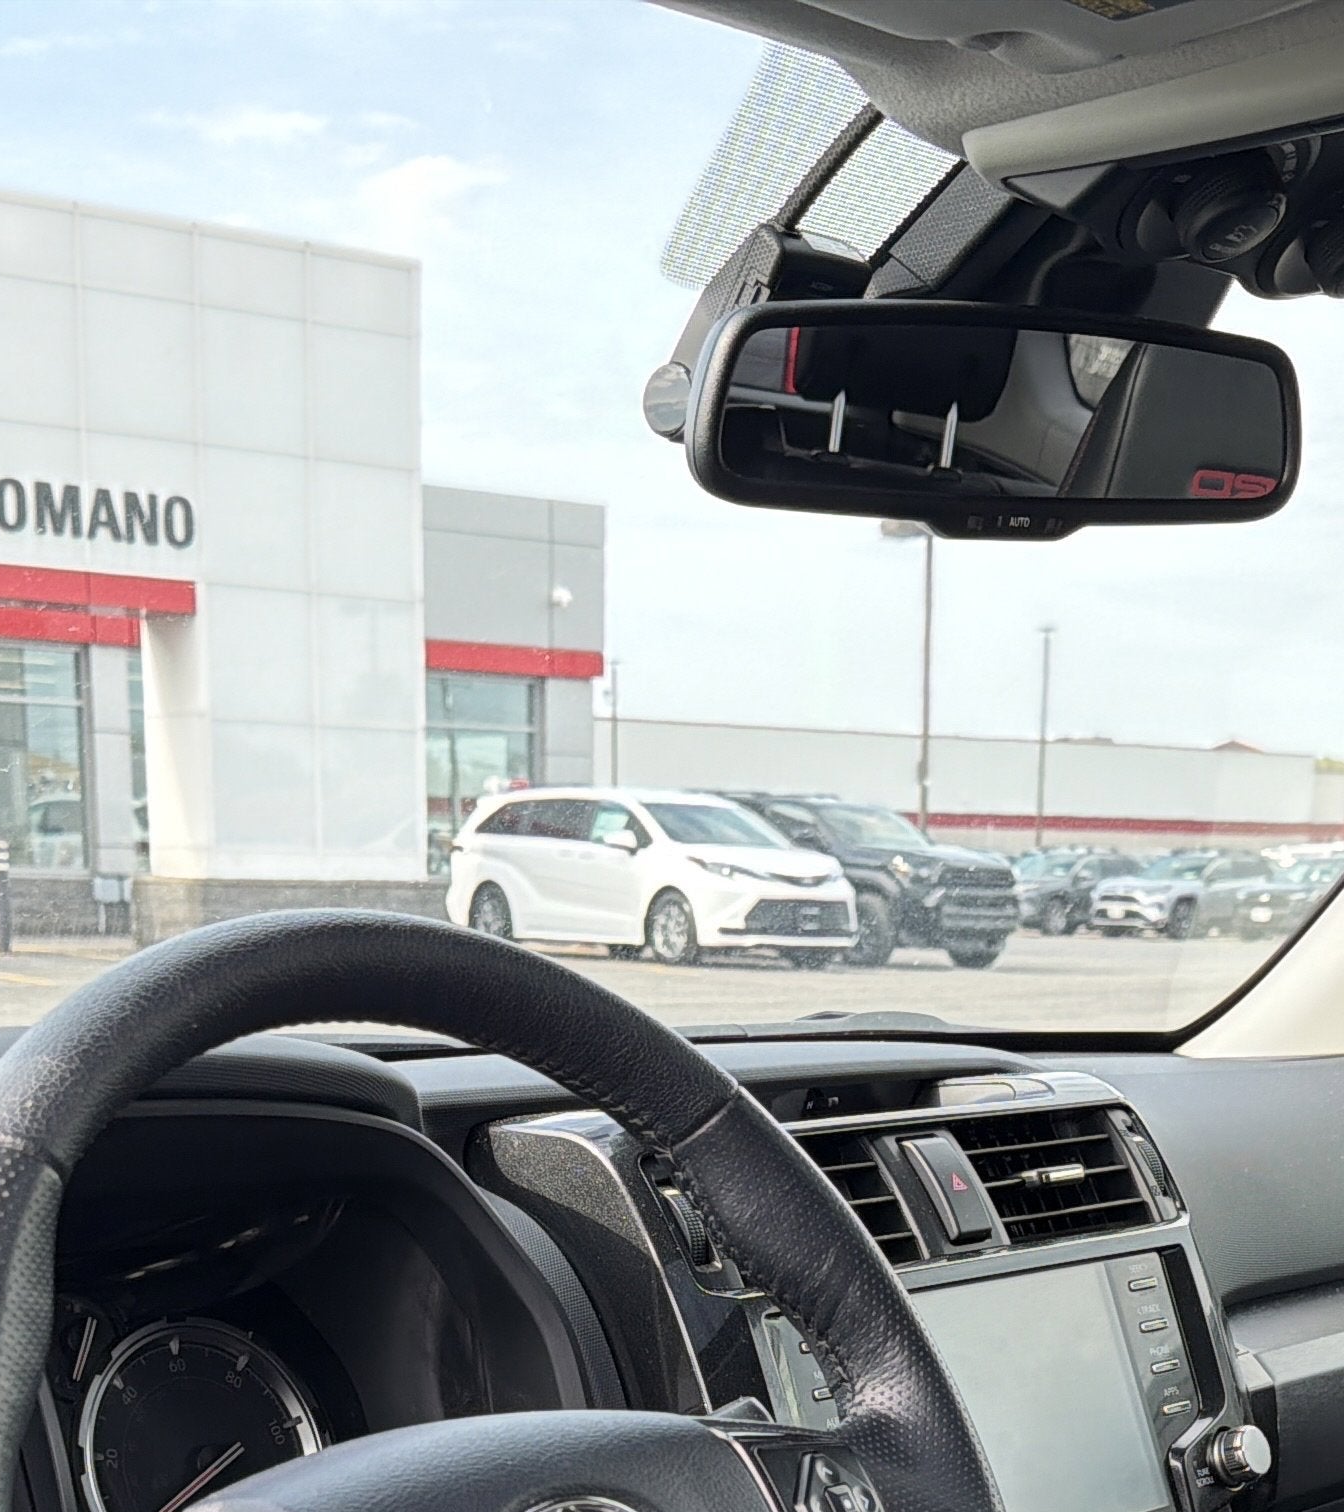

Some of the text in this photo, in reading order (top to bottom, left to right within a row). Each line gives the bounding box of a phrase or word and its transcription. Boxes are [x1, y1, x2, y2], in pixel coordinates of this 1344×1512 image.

[1009, 516, 1030, 528] AUTO
[169, 1358, 186, 1373] 60
[225, 1371, 243, 1389] 80
[121, 1385, 139, 1406] 40
[1163, 1385, 1180, 1398] APPS
[268, 1419, 286, 1446] 100
[106, 1447, 119, 1469] 20
